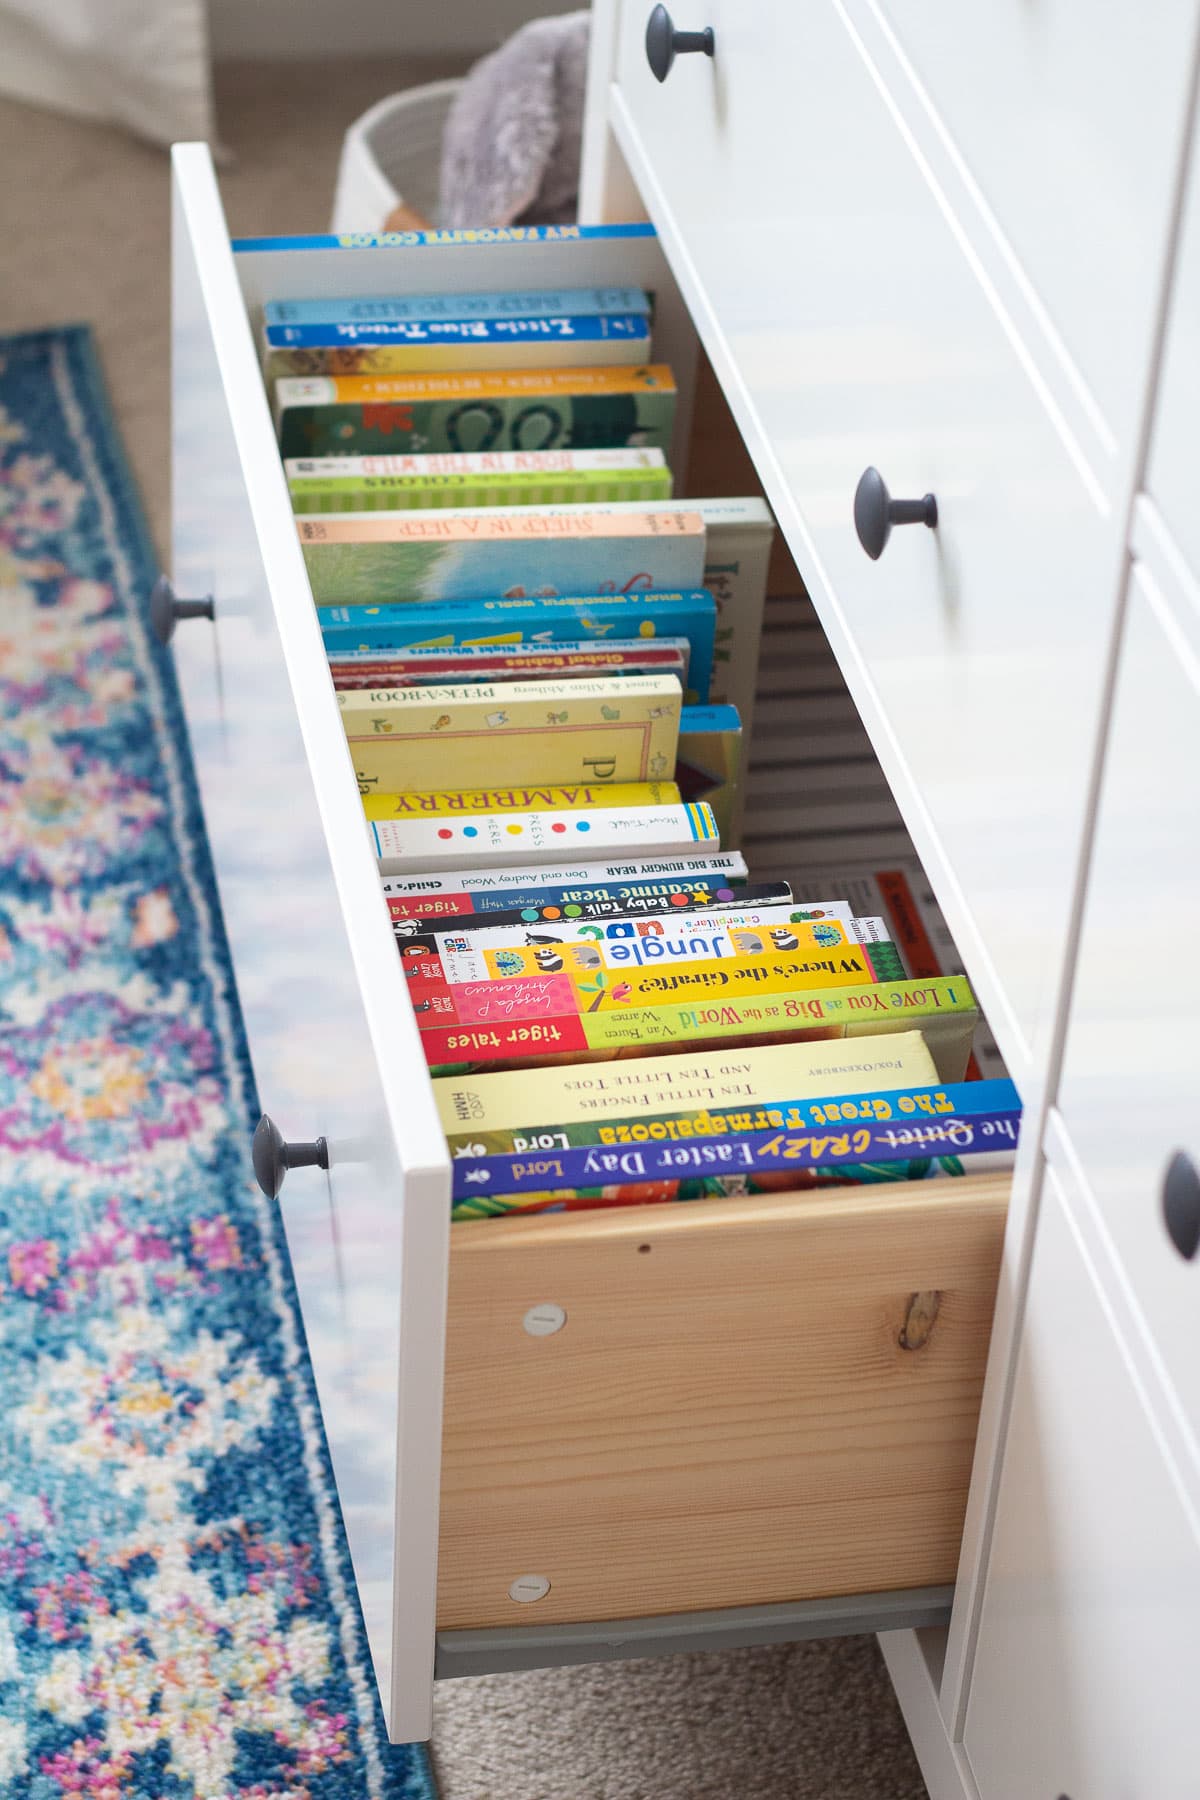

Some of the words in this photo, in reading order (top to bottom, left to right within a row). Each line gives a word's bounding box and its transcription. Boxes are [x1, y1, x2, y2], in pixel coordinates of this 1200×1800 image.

[339, 232, 420, 249] COLOR
[426, 228, 538, 246] FAVORITE
[336, 323, 428, 339] Truck
[429, 321, 489, 337] Blue
[495, 319, 575, 336] Little
[399, 522, 453, 537] JEEP
[462, 520, 479, 534] A
[488, 520, 514, 535] IN
[408, 647, 475, 659] Whispers
[477, 645, 518, 658] Night
[568, 653, 625, 667] Global
[370, 687, 496, 704] PEEK-A-BOO!
[513, 686, 564, 697] Ahlberg
[569, 684, 604, 692] Allan
[394, 788, 596, 813] JAMBERRY
[488, 818, 502, 846] HERE
[527, 814, 545, 847] PRESS
[605, 865, 637, 876] BEAR
[639, 861, 685, 875] HUNGRY
[687, 859, 706, 871] BIG
[708, 857, 735, 869] THE
[498, 871, 538, 885] Audrey
[540, 873, 562, 883] and
[564, 869, 589, 881] Don
[396, 880, 443, 892] Child's
[460, 878, 496, 889] Wood
[480, 897, 504, 909] Huff
[507, 896, 545, 908] Morgan
[560, 889, 611, 907] Bear
[627, 895, 669, 911] Baby
[414, 902, 460, 917] tiger
[584, 901, 624, 915] Talk
[684, 915, 760, 930] Caterpillar's
[608, 935, 725, 967] Jungle
[735, 968, 769, 985] the
[771, 957, 864, 981] Where's
[464, 978, 556, 998] Arrhenius
[637, 970, 730, 993] Giraffe?
[494, 994, 552, 1014] Ingela
[846, 994, 889, 1012] You
[889, 988, 943, 1009] Love
[946, 988, 958, 1004] I
[476, 1001, 492, 1017] P
[764, 1006, 781, 1018] as
[783, 999, 826, 1020] Big
[824, 1000, 844, 1011] as
[610, 1010, 662, 1024] Warnes
[677, 1007, 743, 1030] World
[741, 1009, 762, 1022] the
[506, 1024, 562, 1043] tiger
[603, 1027, 646, 1041] Buren
[646, 1024, 677, 1038] Van
[446, 1030, 501, 1050] tales
[678, 1067, 713, 1081] TEN
[719, 1062, 753, 1076] AND
[807, 1059, 903, 1077] FOX/OXENBURY
[563, 1078, 607, 1092] TOES
[608, 1071, 673, 1087] LITTLE
[651, 1088, 715, 1103] LITTLE
[720, 1083, 757, 1097] TEN
[451, 1091, 473, 1121] HMH
[578, 1094, 651, 1110] FINGERS
[897, 1093, 956, 1118] The
[809, 1099, 893, 1125] Great
[598, 1107, 807, 1146] Farmapalooza
[884, 1118, 975, 1151] Quiet
[981, 1119, 1018, 1141] he
[511, 1132, 571, 1154] Lord
[757, 1129, 872, 1161] CRAZY
[583, 1148, 648, 1178] Day
[656, 1141, 755, 1170] Easter
[510, 1158, 565, 1180] Lord
